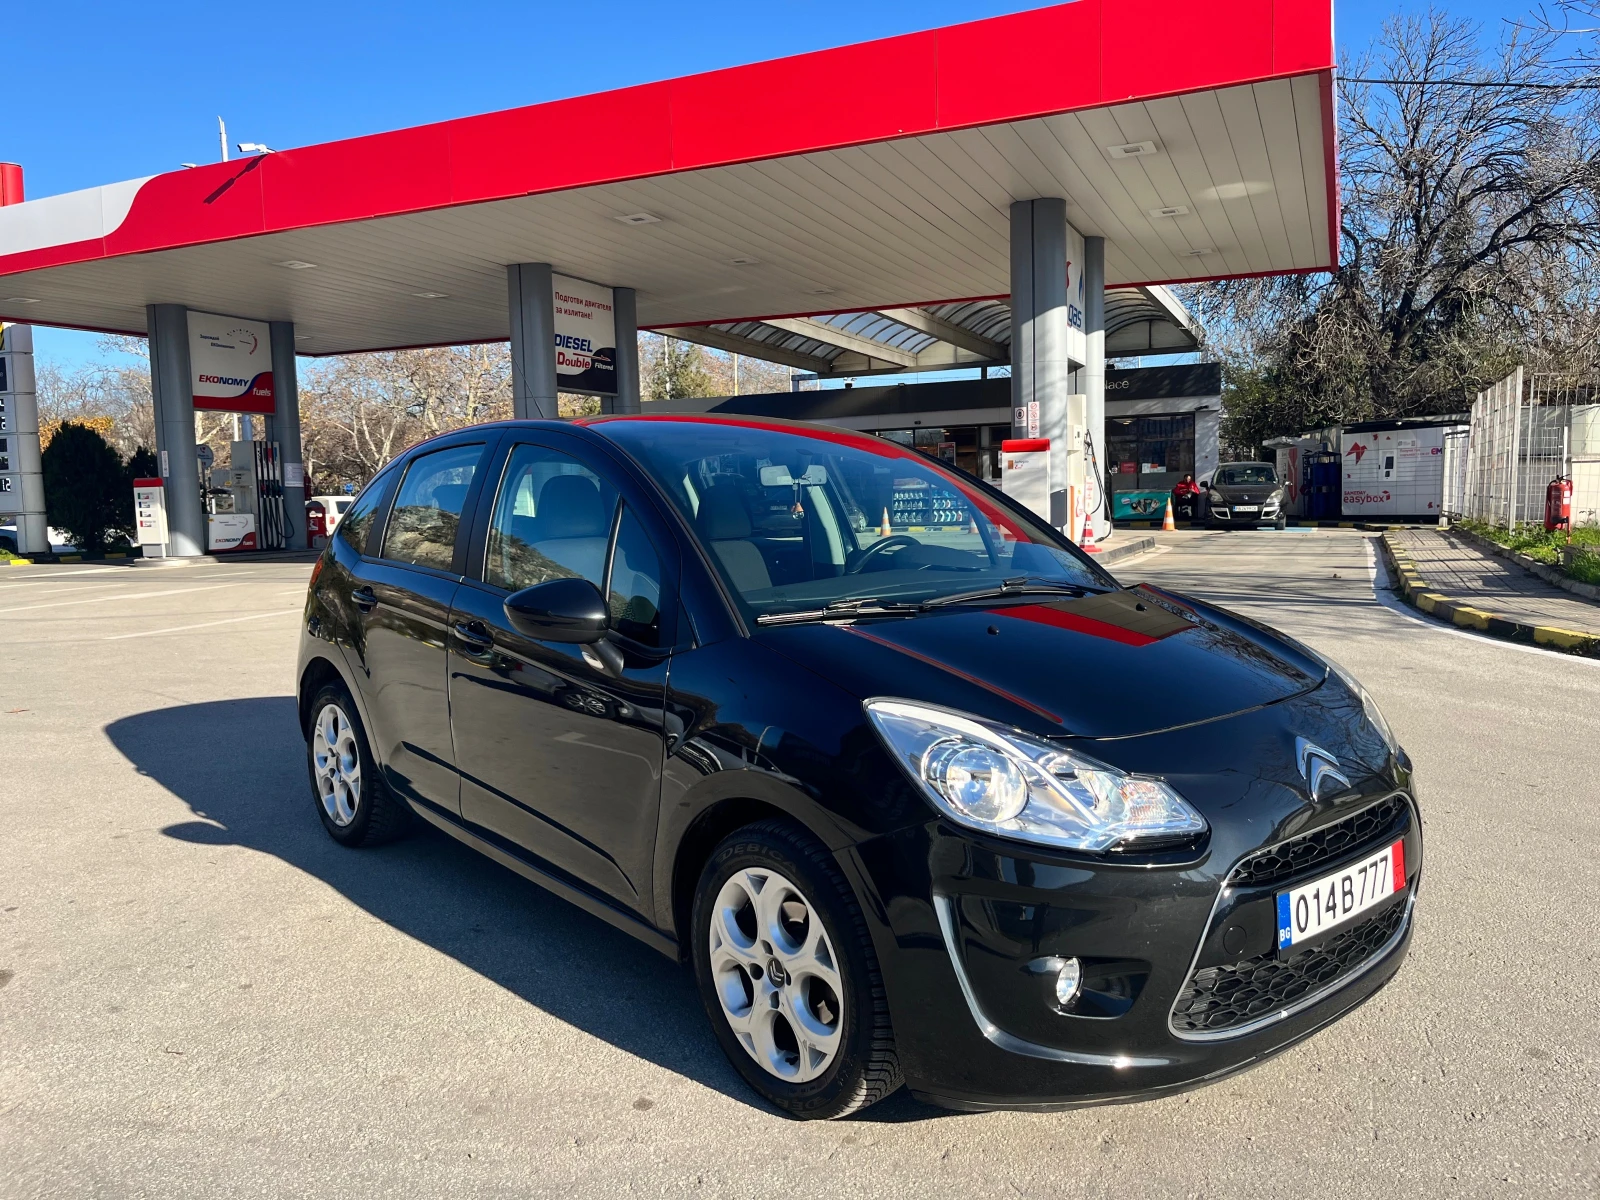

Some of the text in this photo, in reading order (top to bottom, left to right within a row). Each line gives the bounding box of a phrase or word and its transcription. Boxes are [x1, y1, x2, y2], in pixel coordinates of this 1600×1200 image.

[555, 291, 612, 312] Подготви двигателя
[555, 306, 593, 320] за излитане!
[1068, 304, 1082, 328] gas
[555, 333, 593, 353] DIESEL
[557, 351, 590, 369] Double
[594, 362, 614, 371] Filtered
[199, 374, 249, 387] EKONOMY
[1104, 380, 1129, 390] lace
[253, 387, 271, 396] fuels
[1343, 494, 1385, 505] easybox
[1295, 854, 1388, 934] 014B777
[1279, 926, 1292, 942] BG
